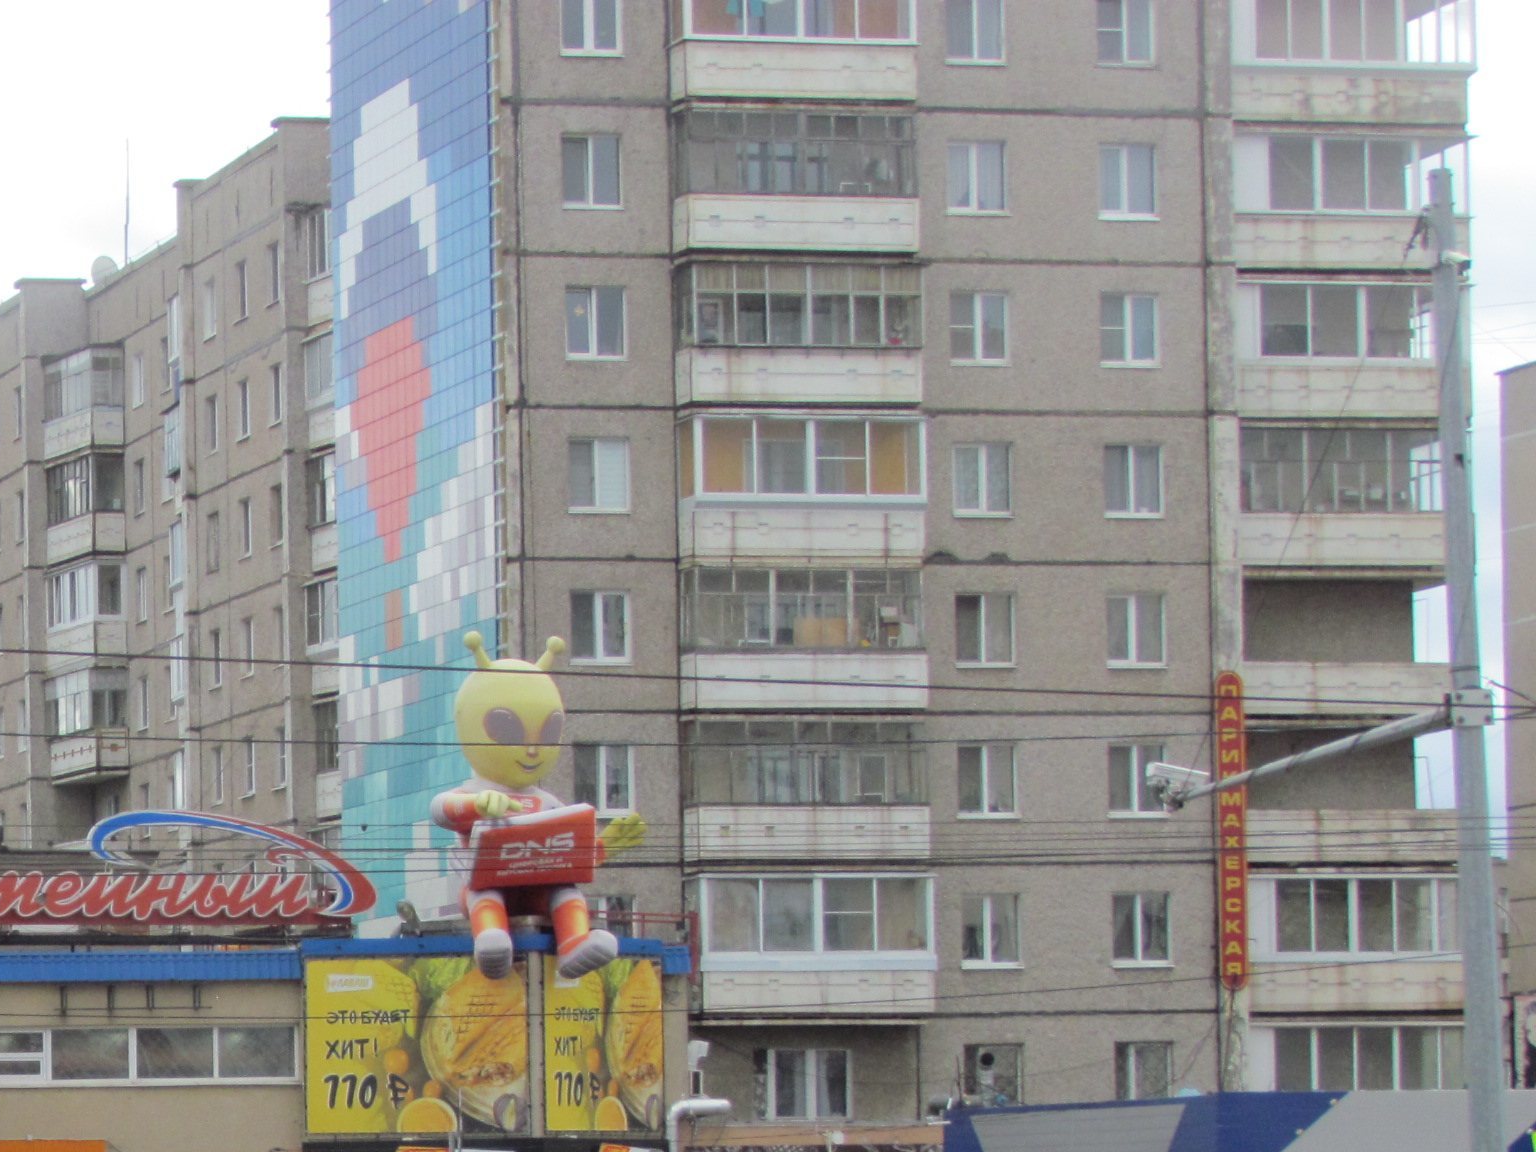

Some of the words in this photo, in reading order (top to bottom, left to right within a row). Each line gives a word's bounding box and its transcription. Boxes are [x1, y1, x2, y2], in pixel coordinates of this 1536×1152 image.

[500, 831, 575, 860] DNS
[324, 1073, 379, 1110] 110
[553, 1071, 584, 1107] 110
